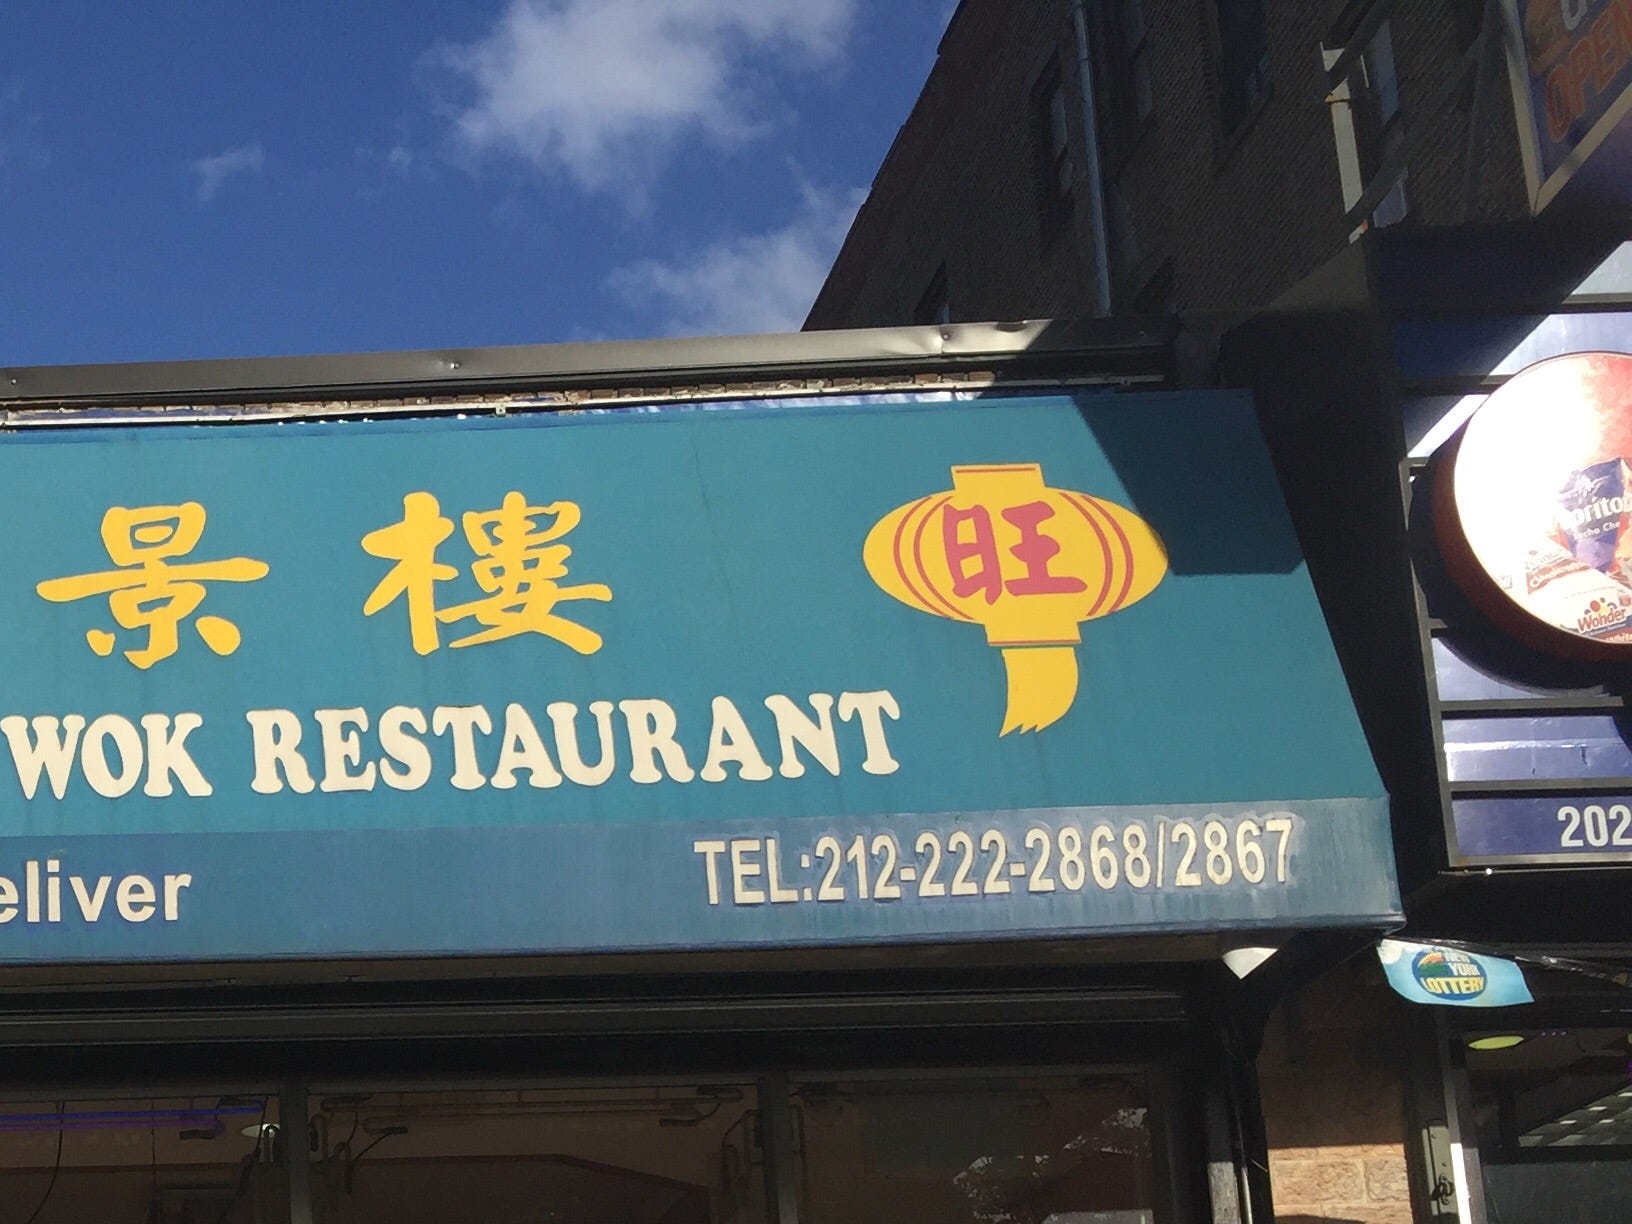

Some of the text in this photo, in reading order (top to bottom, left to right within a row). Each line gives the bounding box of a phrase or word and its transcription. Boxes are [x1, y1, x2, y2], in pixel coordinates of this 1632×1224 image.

[942, 501, 1088, 605] 旺
[0, 713, 213, 800] WOK
[246, 690, 900, 794] RESTAURANT
[694, 819, 1293, 905] TEL:212-222-2868/2867
[1421, 976, 1484, 994] LOTTERY
[1447, 962, 1480, 975] YORK
